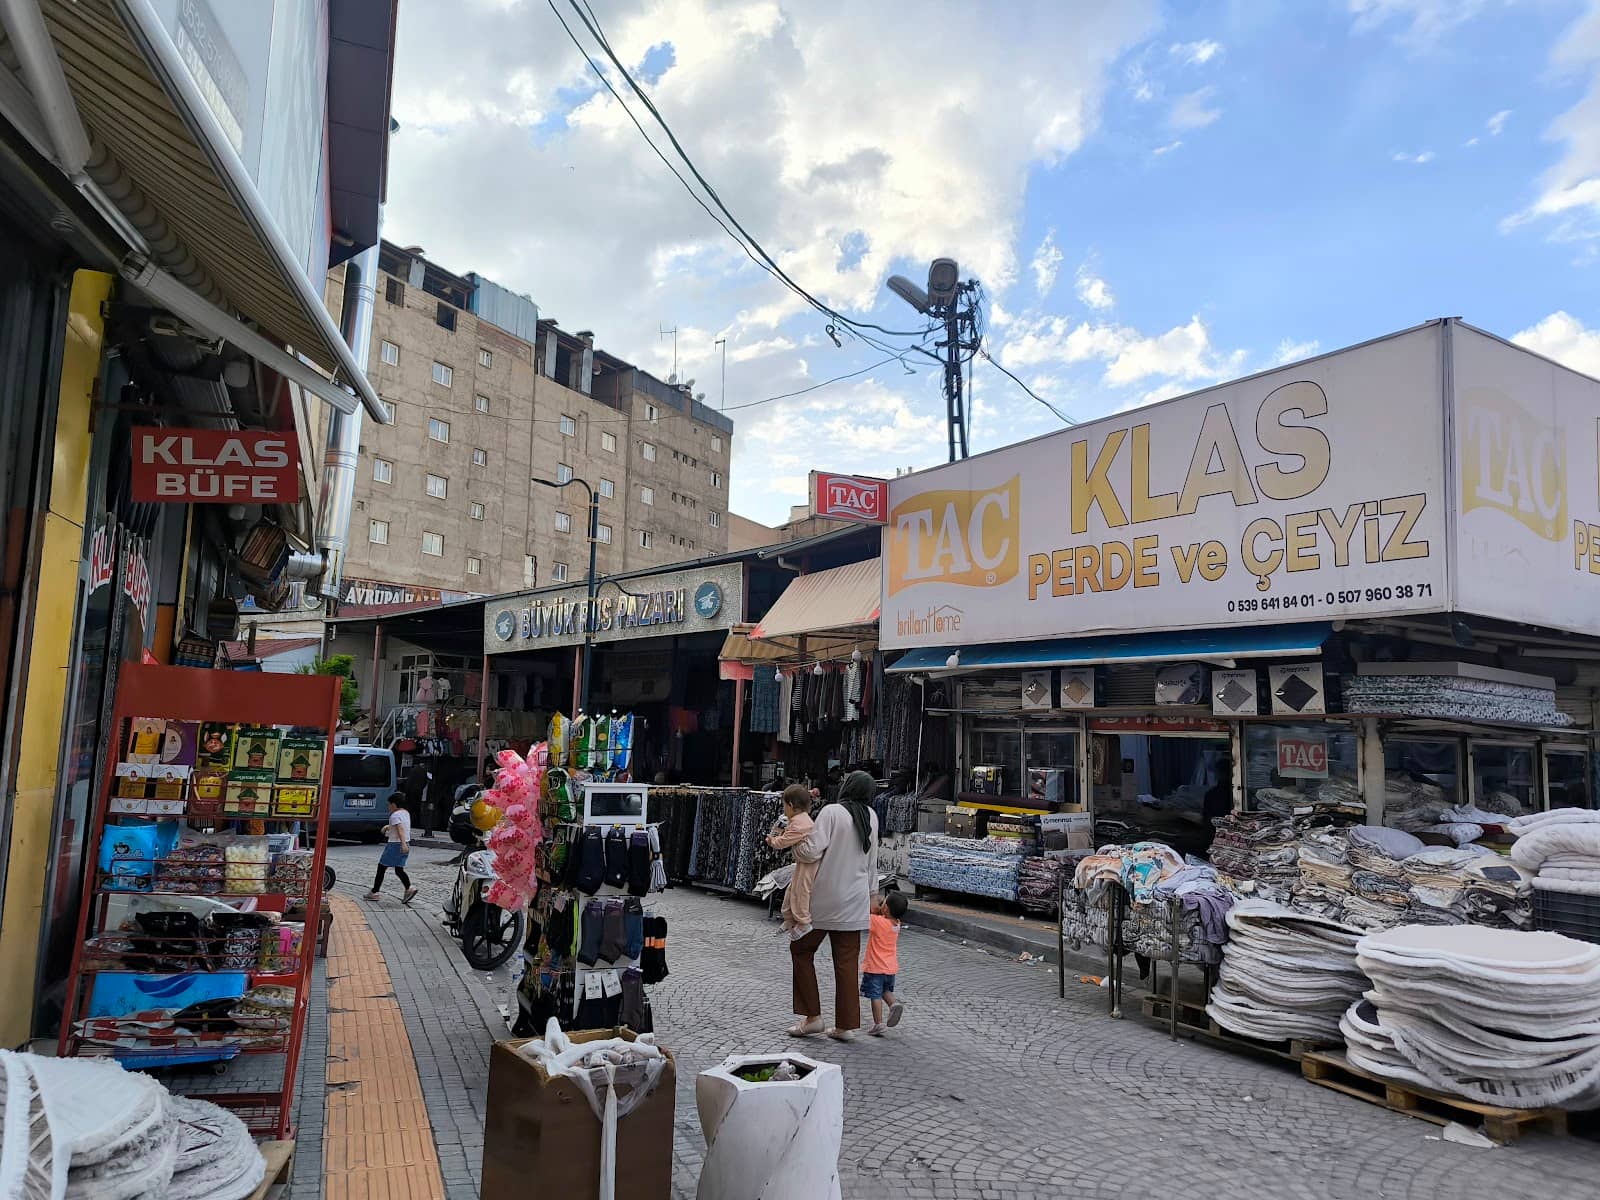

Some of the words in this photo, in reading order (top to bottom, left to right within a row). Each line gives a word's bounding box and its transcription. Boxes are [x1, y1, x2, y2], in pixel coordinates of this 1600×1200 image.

[142, 435, 289, 468] KLAS
[1071, 380, 1331, 534] KLAS
[156, 468, 278, 498] BÜFE
[896, 488, 1010, 581] TAC
[1028, 534, 1160, 601] PERDE
[1171, 539, 1228, 584] ve
[521, 597, 575, 638] BÜYÜK
[617, 587, 684, 628] PAZARI
[1227, 600, 1235, 612] 0
[1238, 598, 1258, 612] 539
[1261, 597, 1280, 610] 641
[1283, 595, 1298, 609] 84
[1301, 593, 1314, 607] 01
[1326, 592, 1335, 604] 0
[1338, 589, 1361, 603] 507
[1365, 587, 1392, 601] 960
[1395, 584, 1414, 598] 38
[1416, 583, 1432, 597] 71
